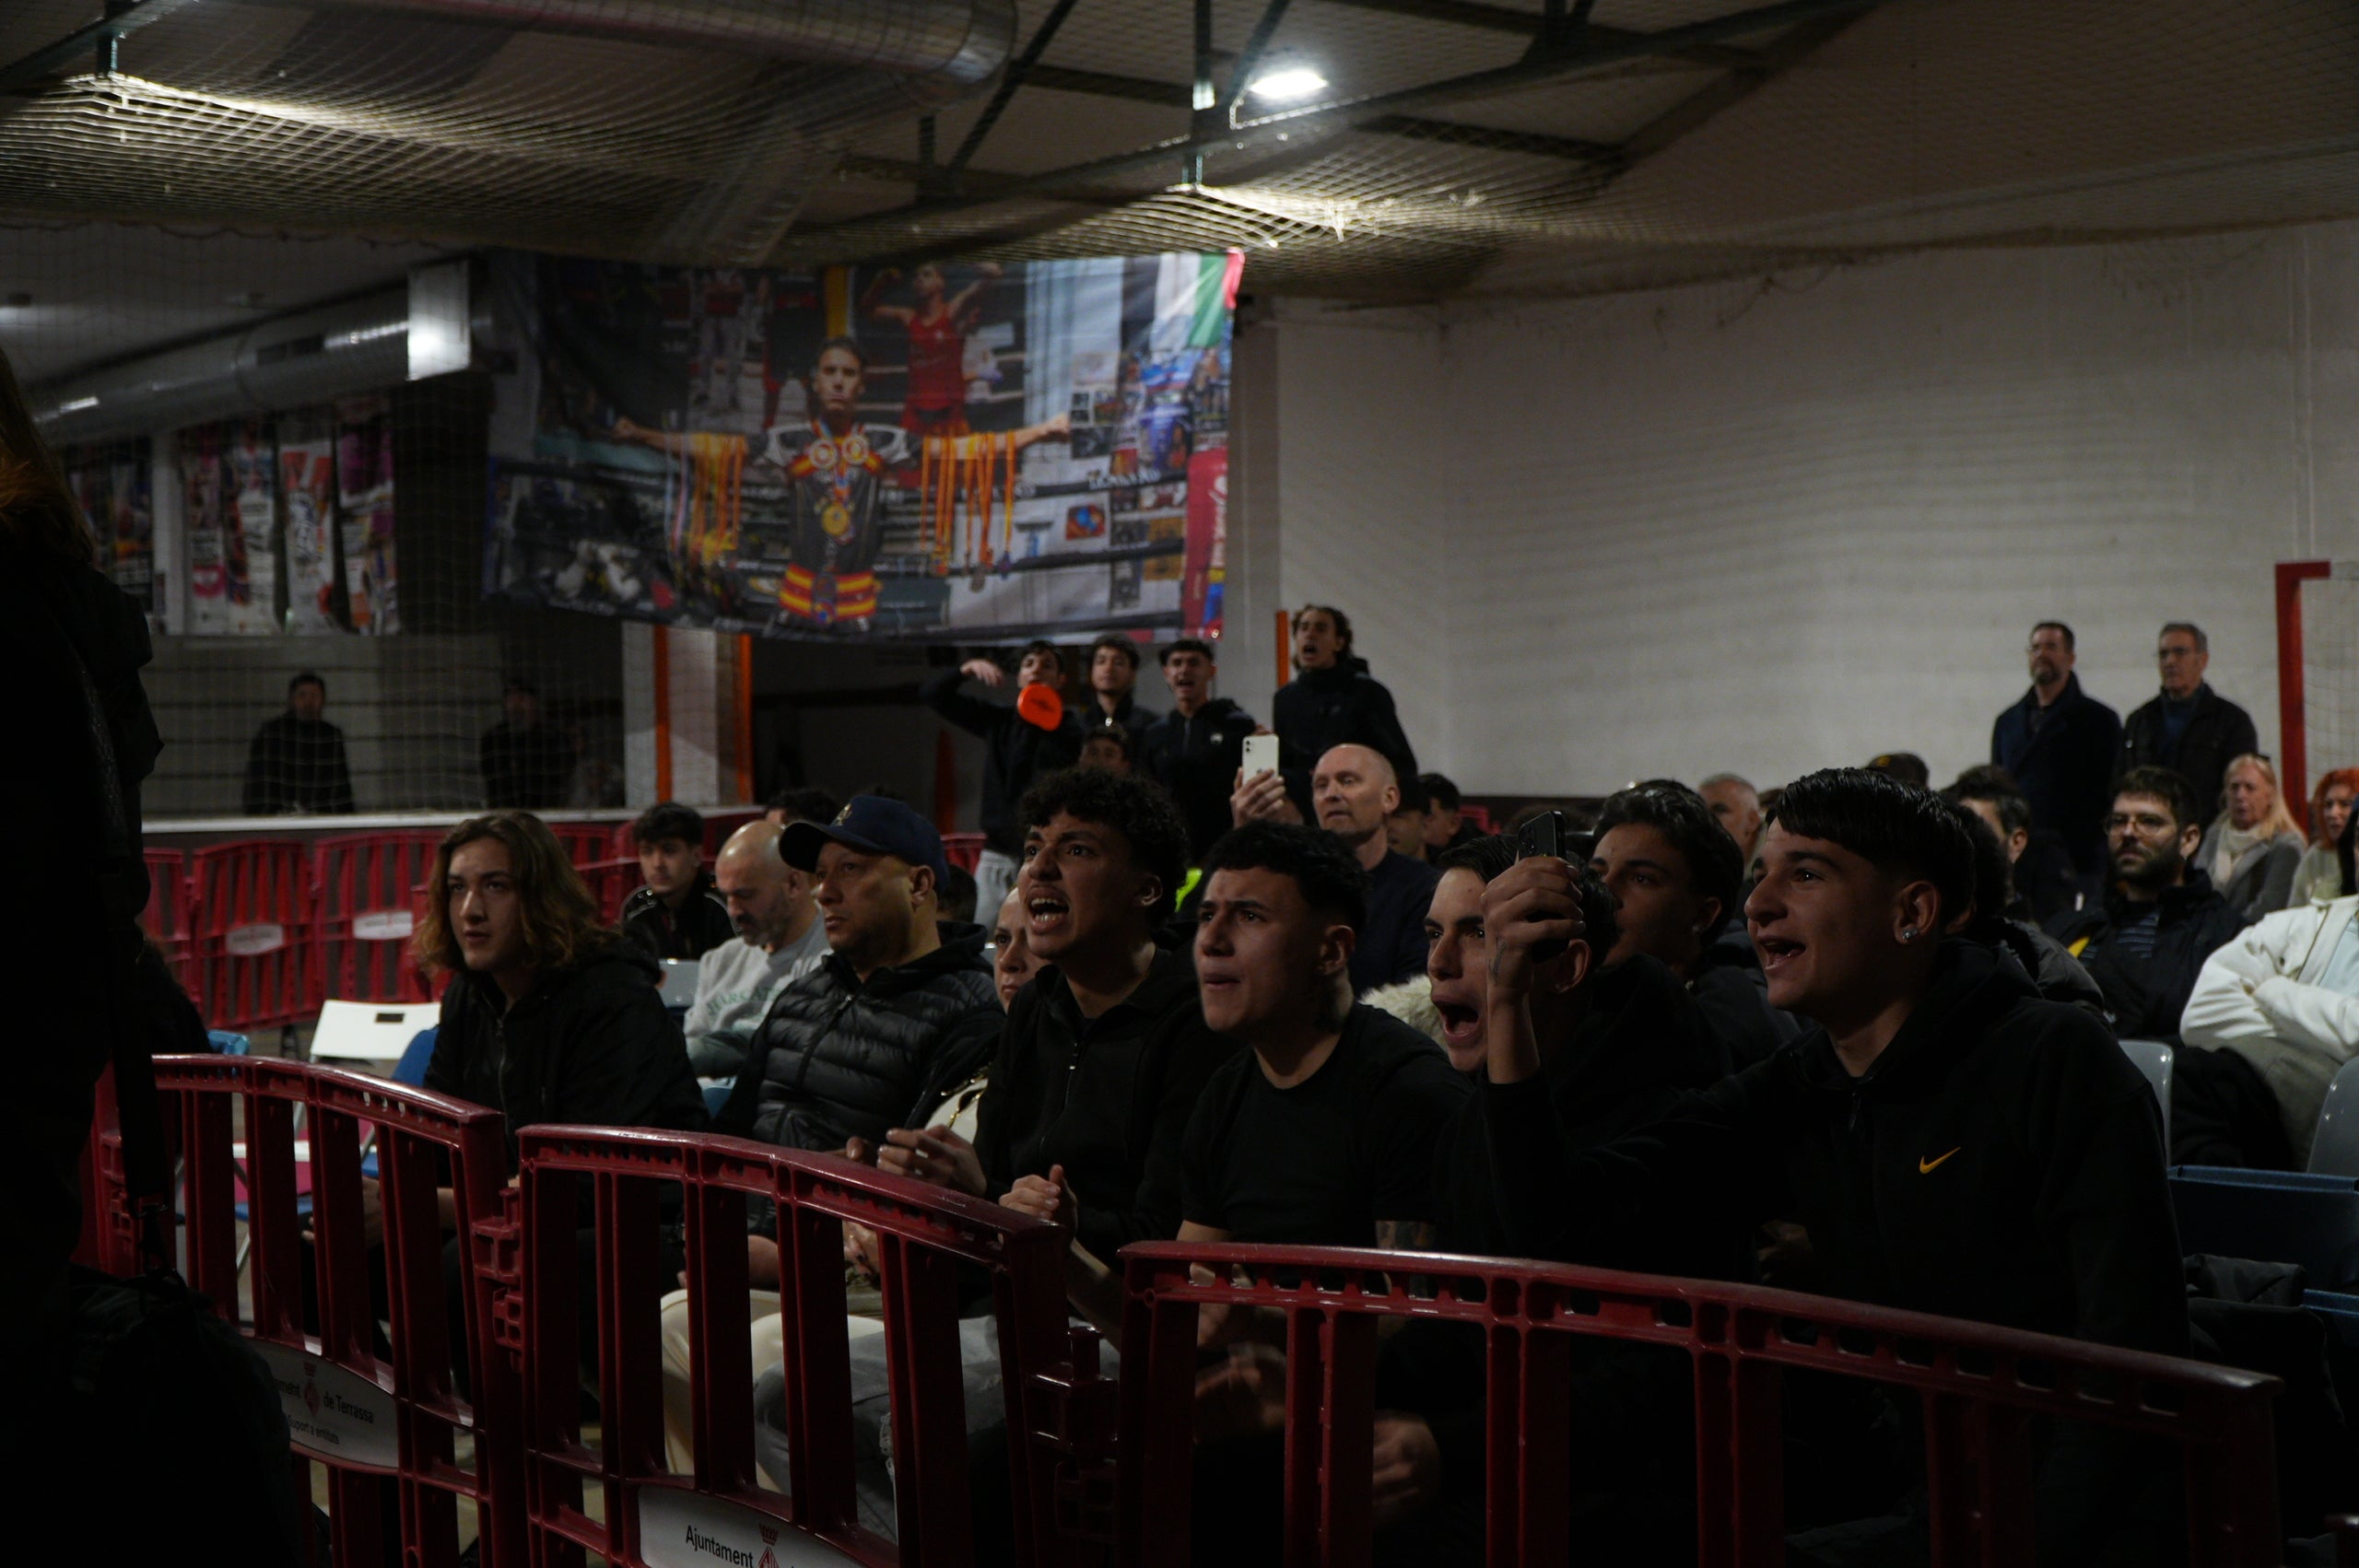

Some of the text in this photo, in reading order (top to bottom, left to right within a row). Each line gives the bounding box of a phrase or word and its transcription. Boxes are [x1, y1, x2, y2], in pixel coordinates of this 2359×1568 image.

[324, 1392, 334, 1410] de
[336, 1395, 373, 1423] Terrassa
[686, 1525, 754, 1568] Ajuntament
